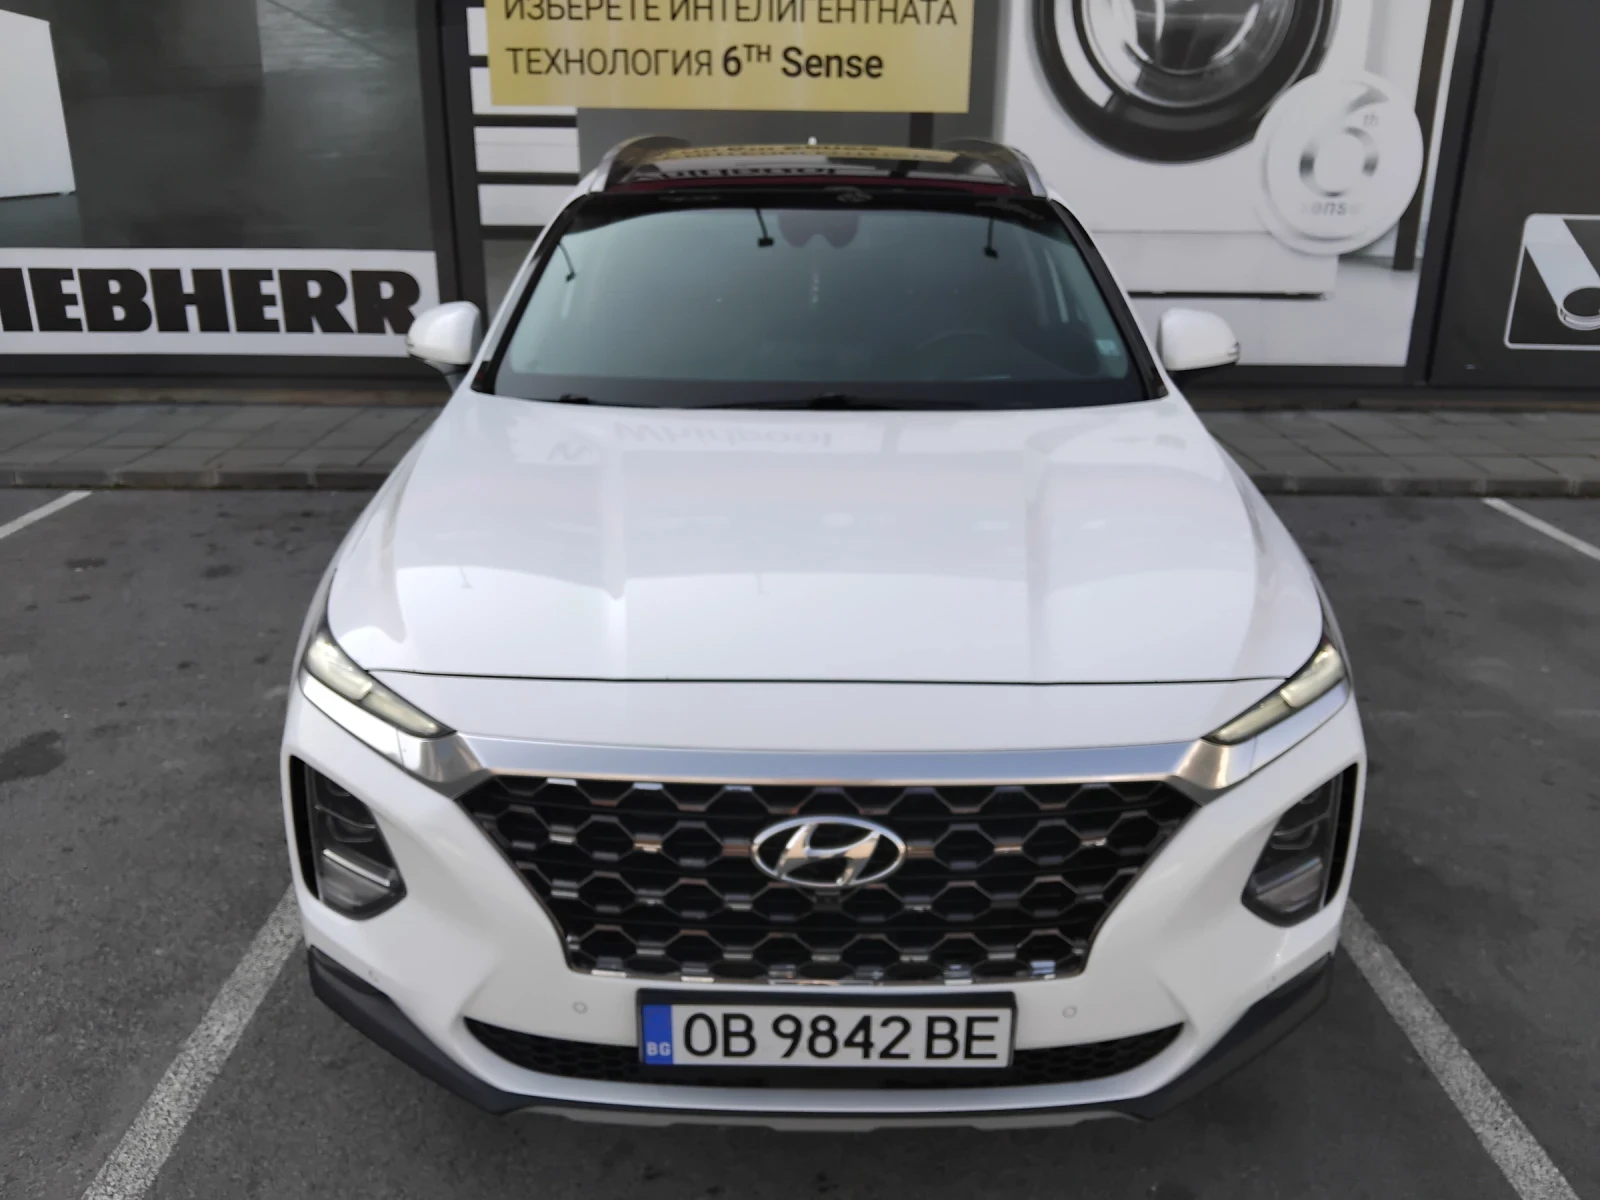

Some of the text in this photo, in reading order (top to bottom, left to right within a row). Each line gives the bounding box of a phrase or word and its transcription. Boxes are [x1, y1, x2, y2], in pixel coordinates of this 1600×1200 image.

[504, 0, 957, 25] ИЗБЕРЕТЕ ИНТЕЛИГЕНТНАТА
[506, 47, 713, 77] ТЕХНОЛОГИЯ
[782, 46, 884, 79] Sense
[646, 1042, 672, 1057] BG
[683, 1012, 1000, 1060] OB 9842 BE
